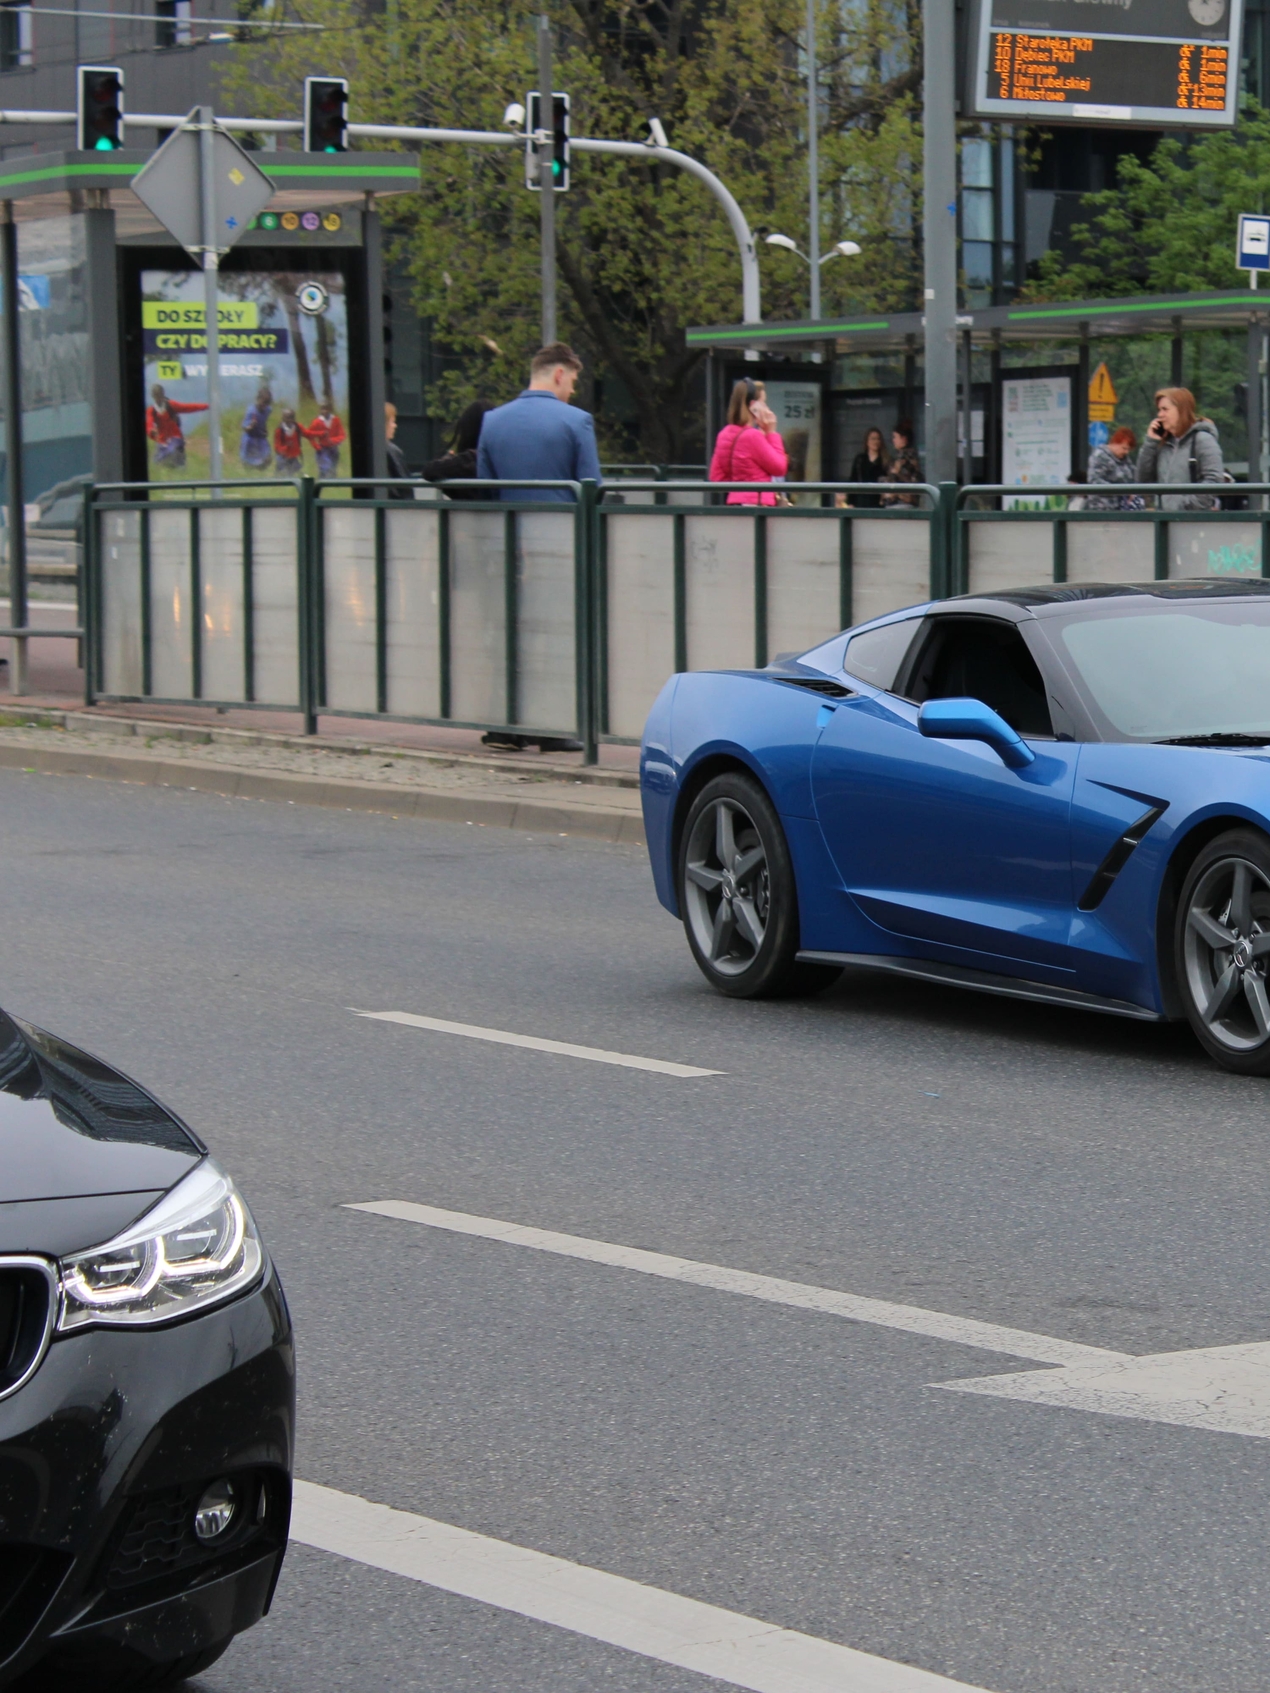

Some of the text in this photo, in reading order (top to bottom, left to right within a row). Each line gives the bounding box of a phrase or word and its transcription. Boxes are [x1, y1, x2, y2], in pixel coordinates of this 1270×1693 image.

[995, 33, 1013, 47] 12
[1070, 36, 1093, 51] PKM
[995, 46, 1012, 60] 10
[1052, 49, 1075, 63] PKM
[994, 59, 1011, 73] 18
[1014, 60, 1058, 75] Franowo
[1000, 72, 1010, 86] 5
[999, 85, 1010, 99] 6
[156, 309, 245, 323] DO SZOŁY
[155, 333, 189, 349] CZY
[217, 333, 278, 349] PRACY?
[160, 364, 177, 376] TY
[784, 405, 802, 419] 25
